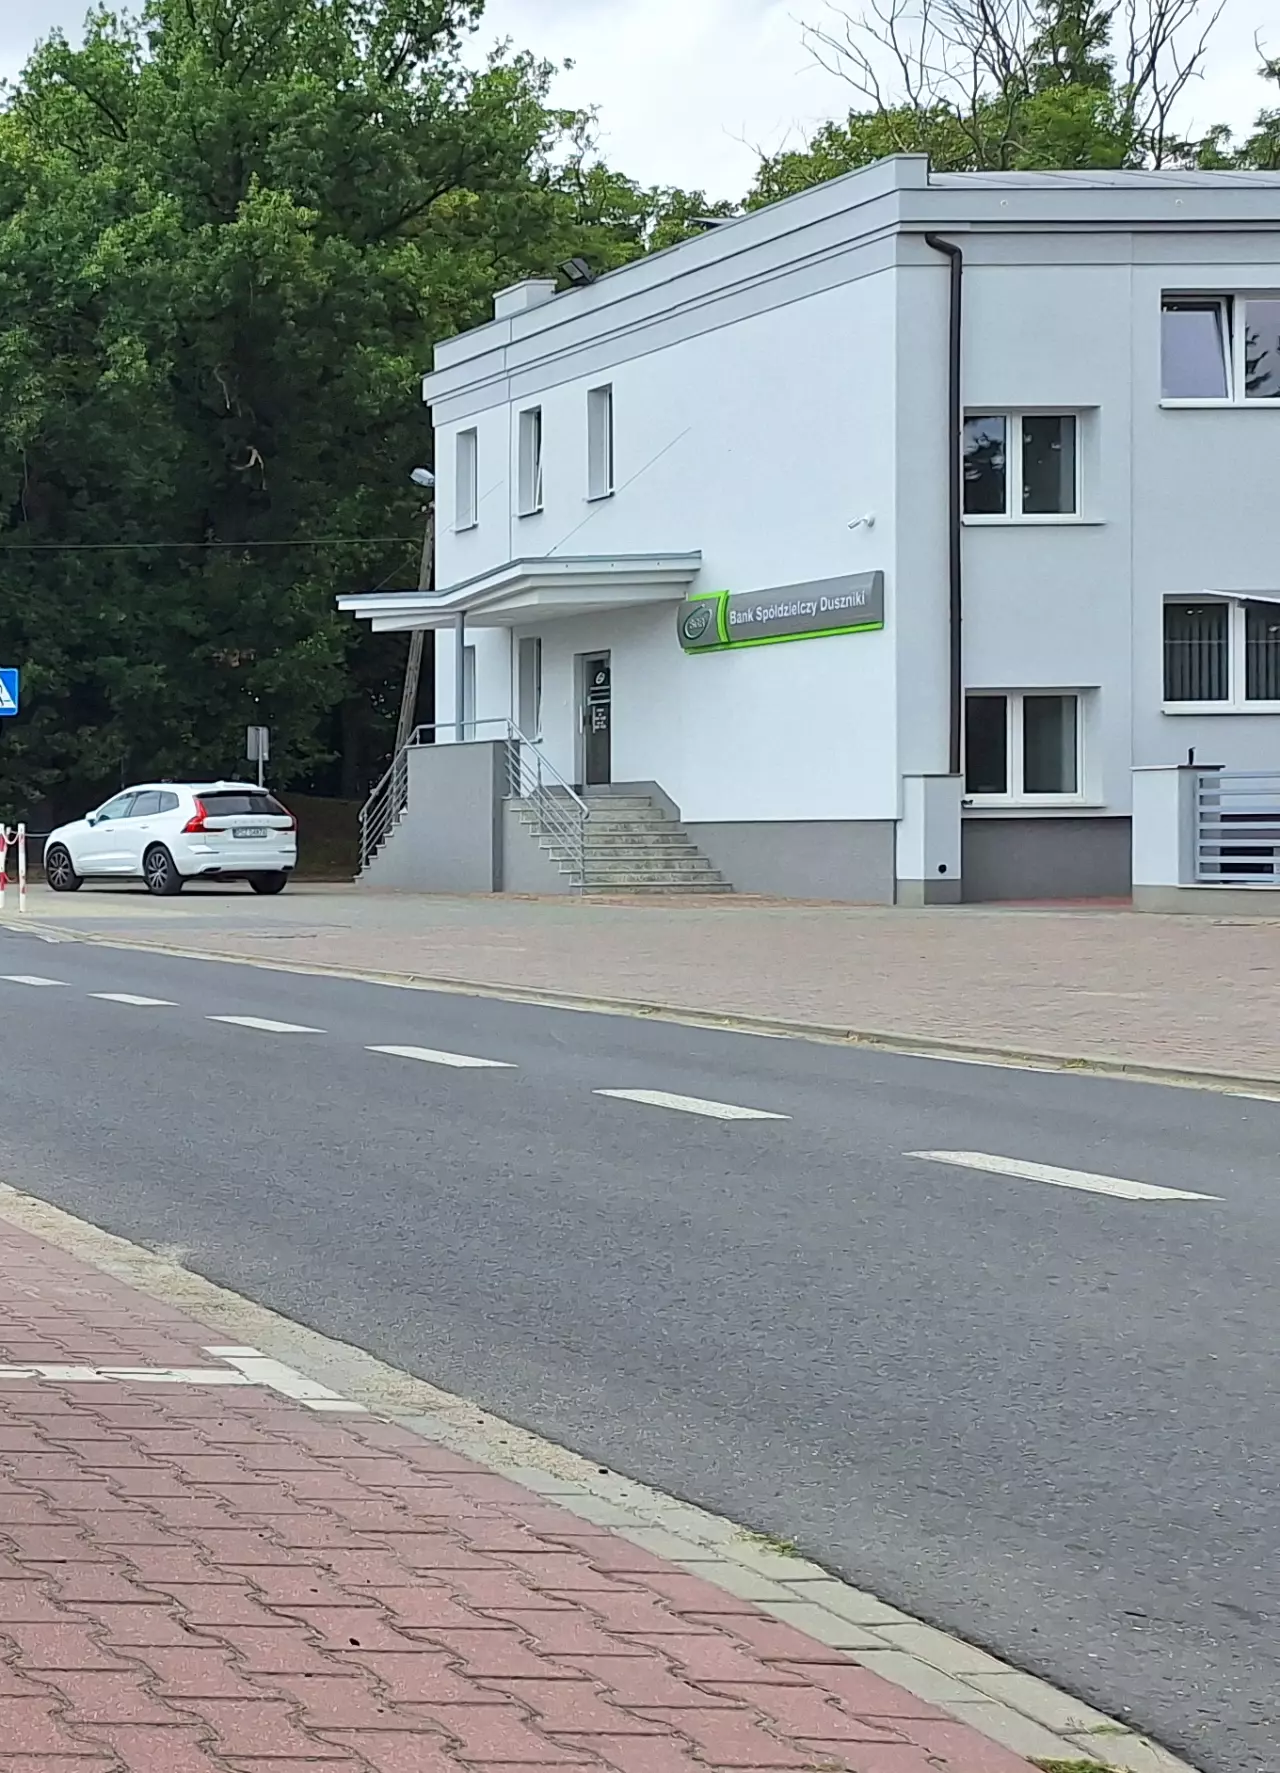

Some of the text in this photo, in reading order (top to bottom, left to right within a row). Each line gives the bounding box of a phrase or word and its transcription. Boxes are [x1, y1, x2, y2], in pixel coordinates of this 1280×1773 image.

[729, 590, 866, 625] Bank Spółdzielczy Duszniki
